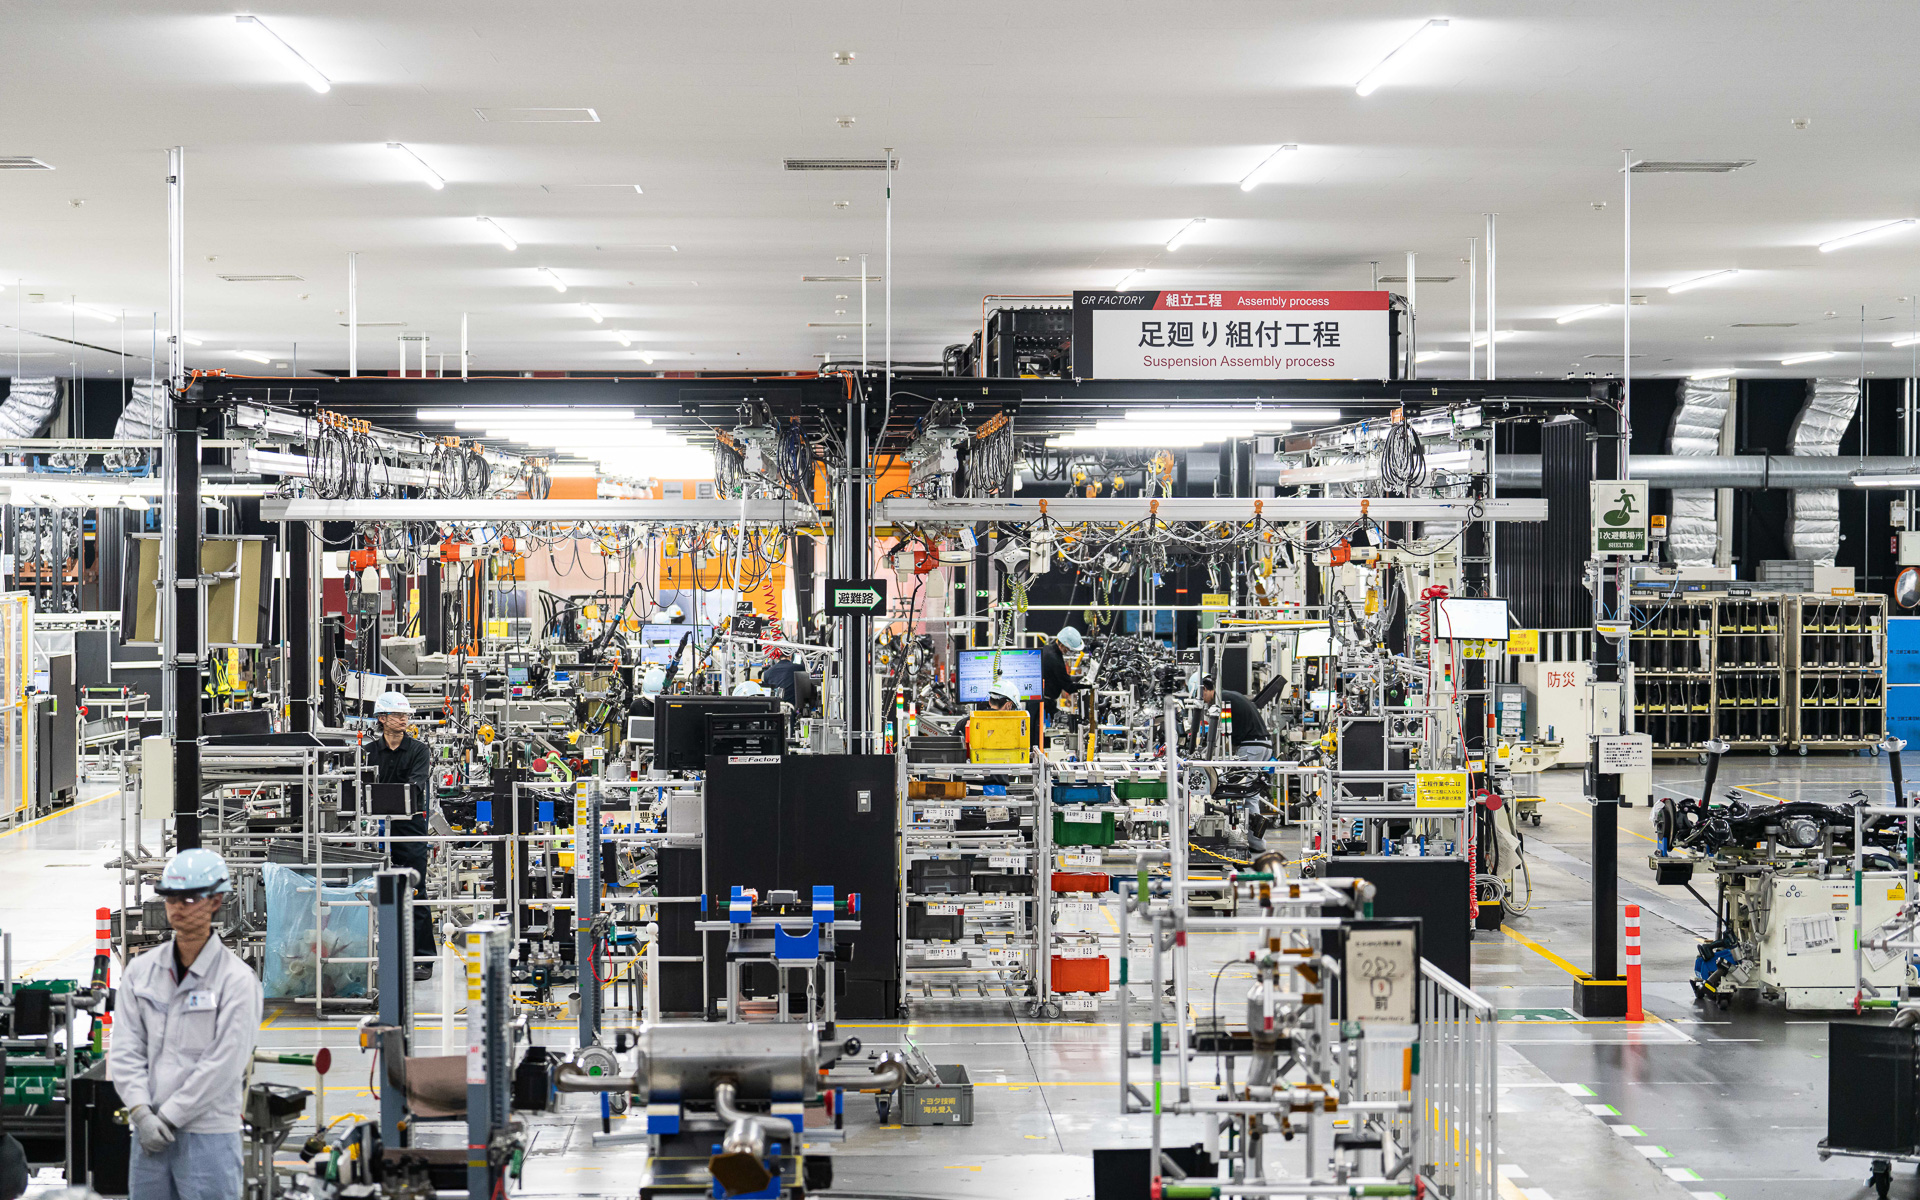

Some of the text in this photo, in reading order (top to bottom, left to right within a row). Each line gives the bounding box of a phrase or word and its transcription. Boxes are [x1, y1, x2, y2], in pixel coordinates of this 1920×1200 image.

[1081, 296, 1144, 304] GR FACTORY
[1166, 293, 1222, 307] 組立工程
[1237, 296, 1330, 307] Assembly process
[1138, 320, 1341, 348] 足廻り組付工程
[1143, 355, 1334, 369] Suspension Assembly process
[838, 592, 873, 604] 避難路
[1548, 671, 1575, 688] 防災
[921, 723, 938, 736] TOYOTA
